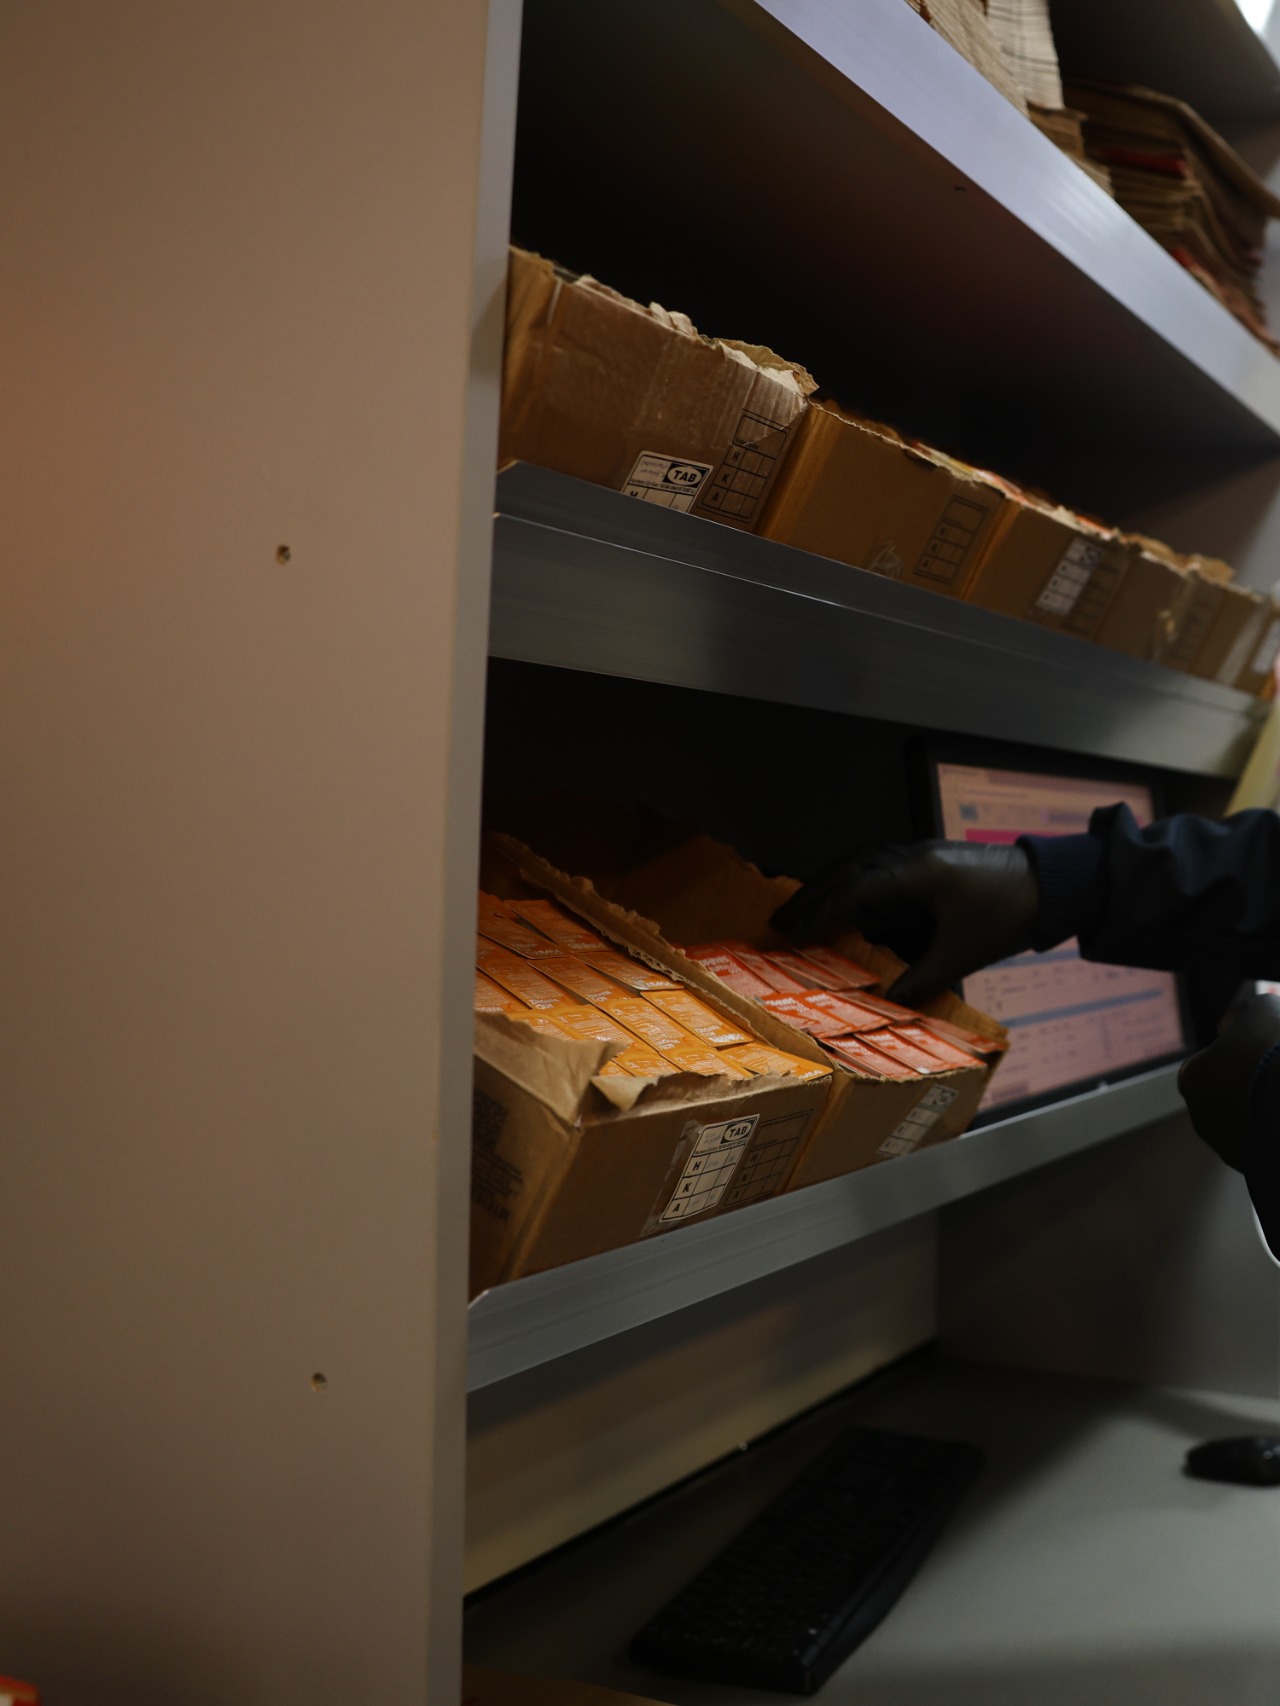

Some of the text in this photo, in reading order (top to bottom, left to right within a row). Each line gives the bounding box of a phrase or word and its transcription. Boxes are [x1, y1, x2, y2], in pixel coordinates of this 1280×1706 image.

[673, 470, 697, 483] TAB
[729, 1125, 748, 1138] TAB
[692, 1160, 702, 1171] H
[682, 1182, 691, 1193] K
[672, 1203, 681, 1213] A
